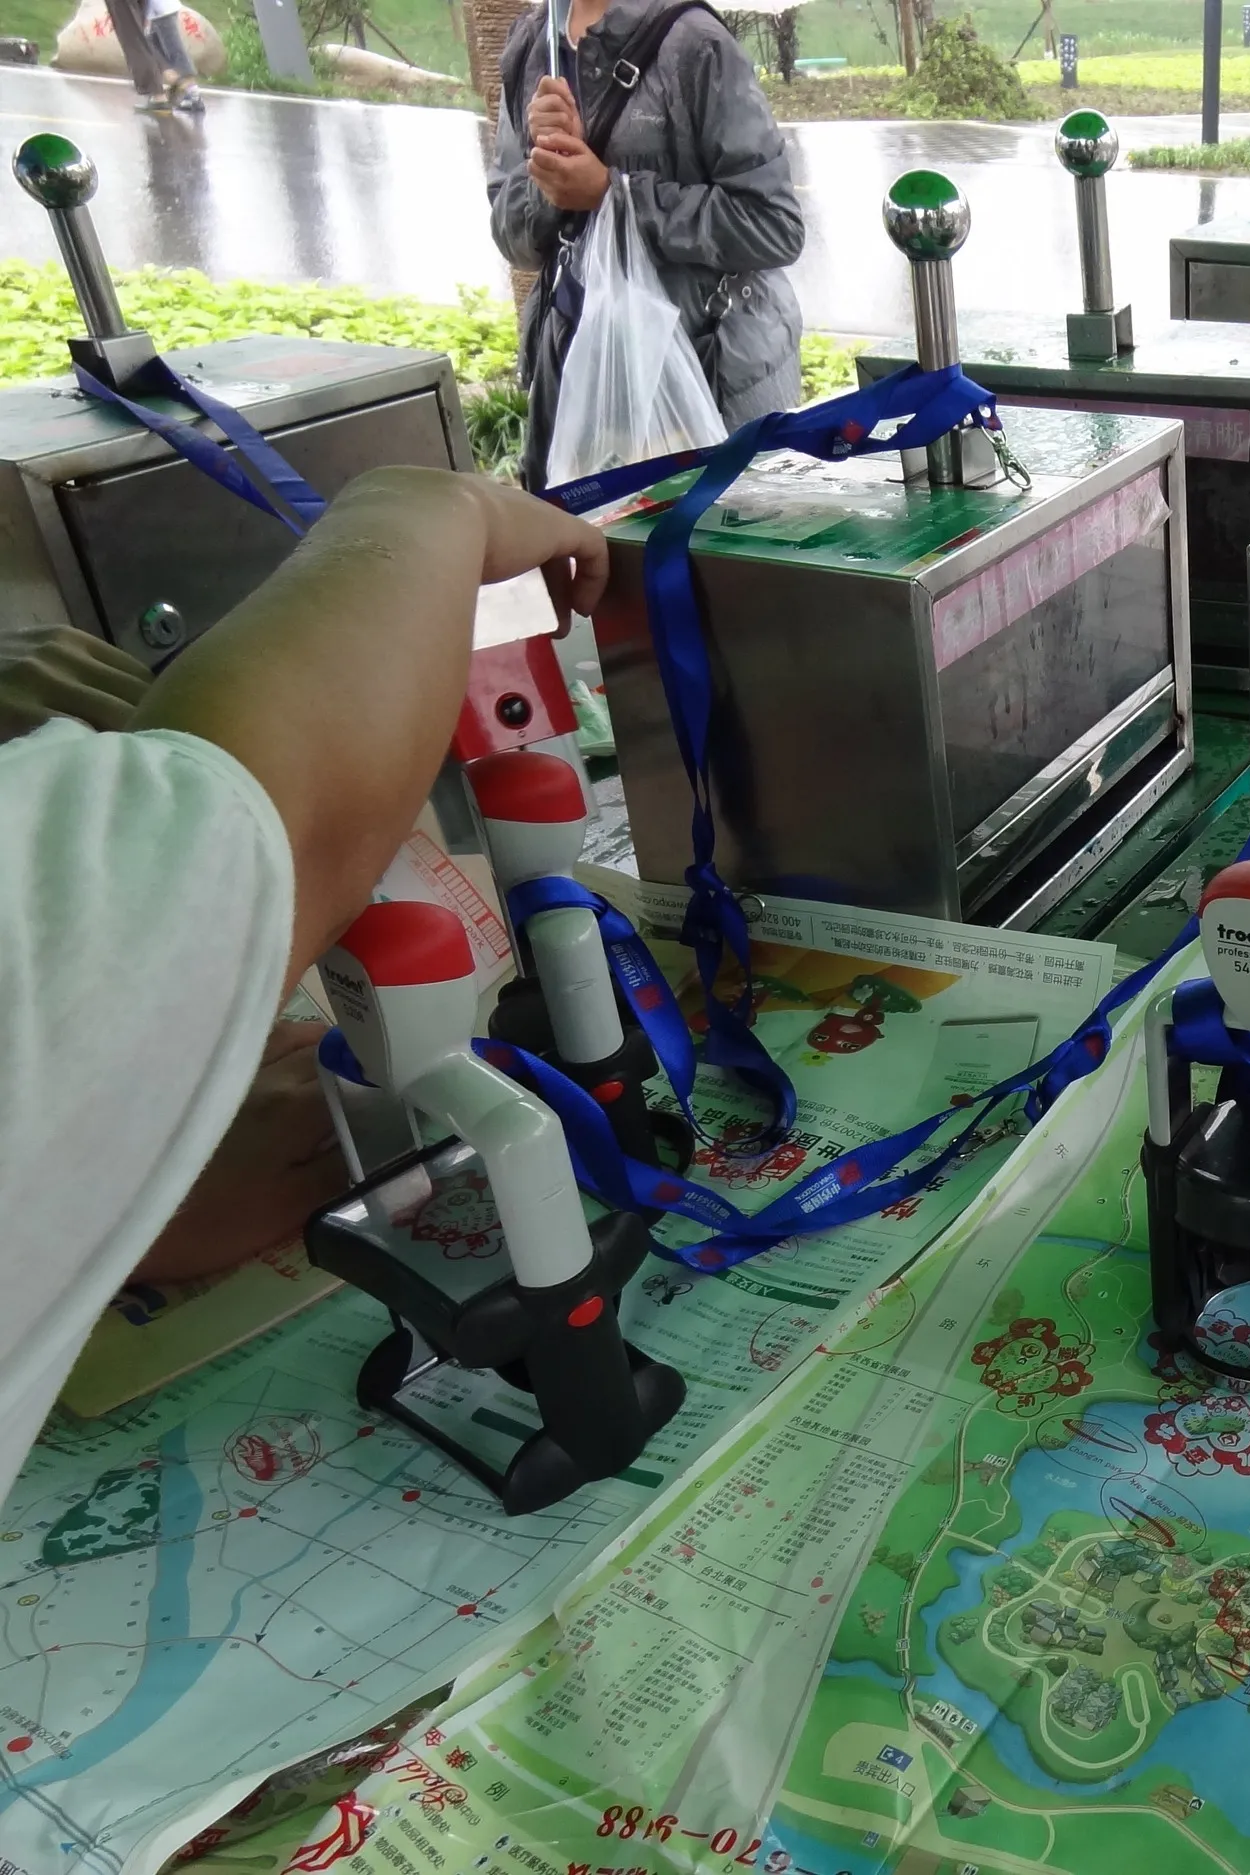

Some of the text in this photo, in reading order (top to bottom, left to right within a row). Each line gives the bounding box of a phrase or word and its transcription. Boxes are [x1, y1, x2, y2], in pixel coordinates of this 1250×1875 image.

[465, 923, 486, 950] park
[893, 1753, 904, 1765] 4
[852, 1759, 917, 1798] 贵宾出入口
